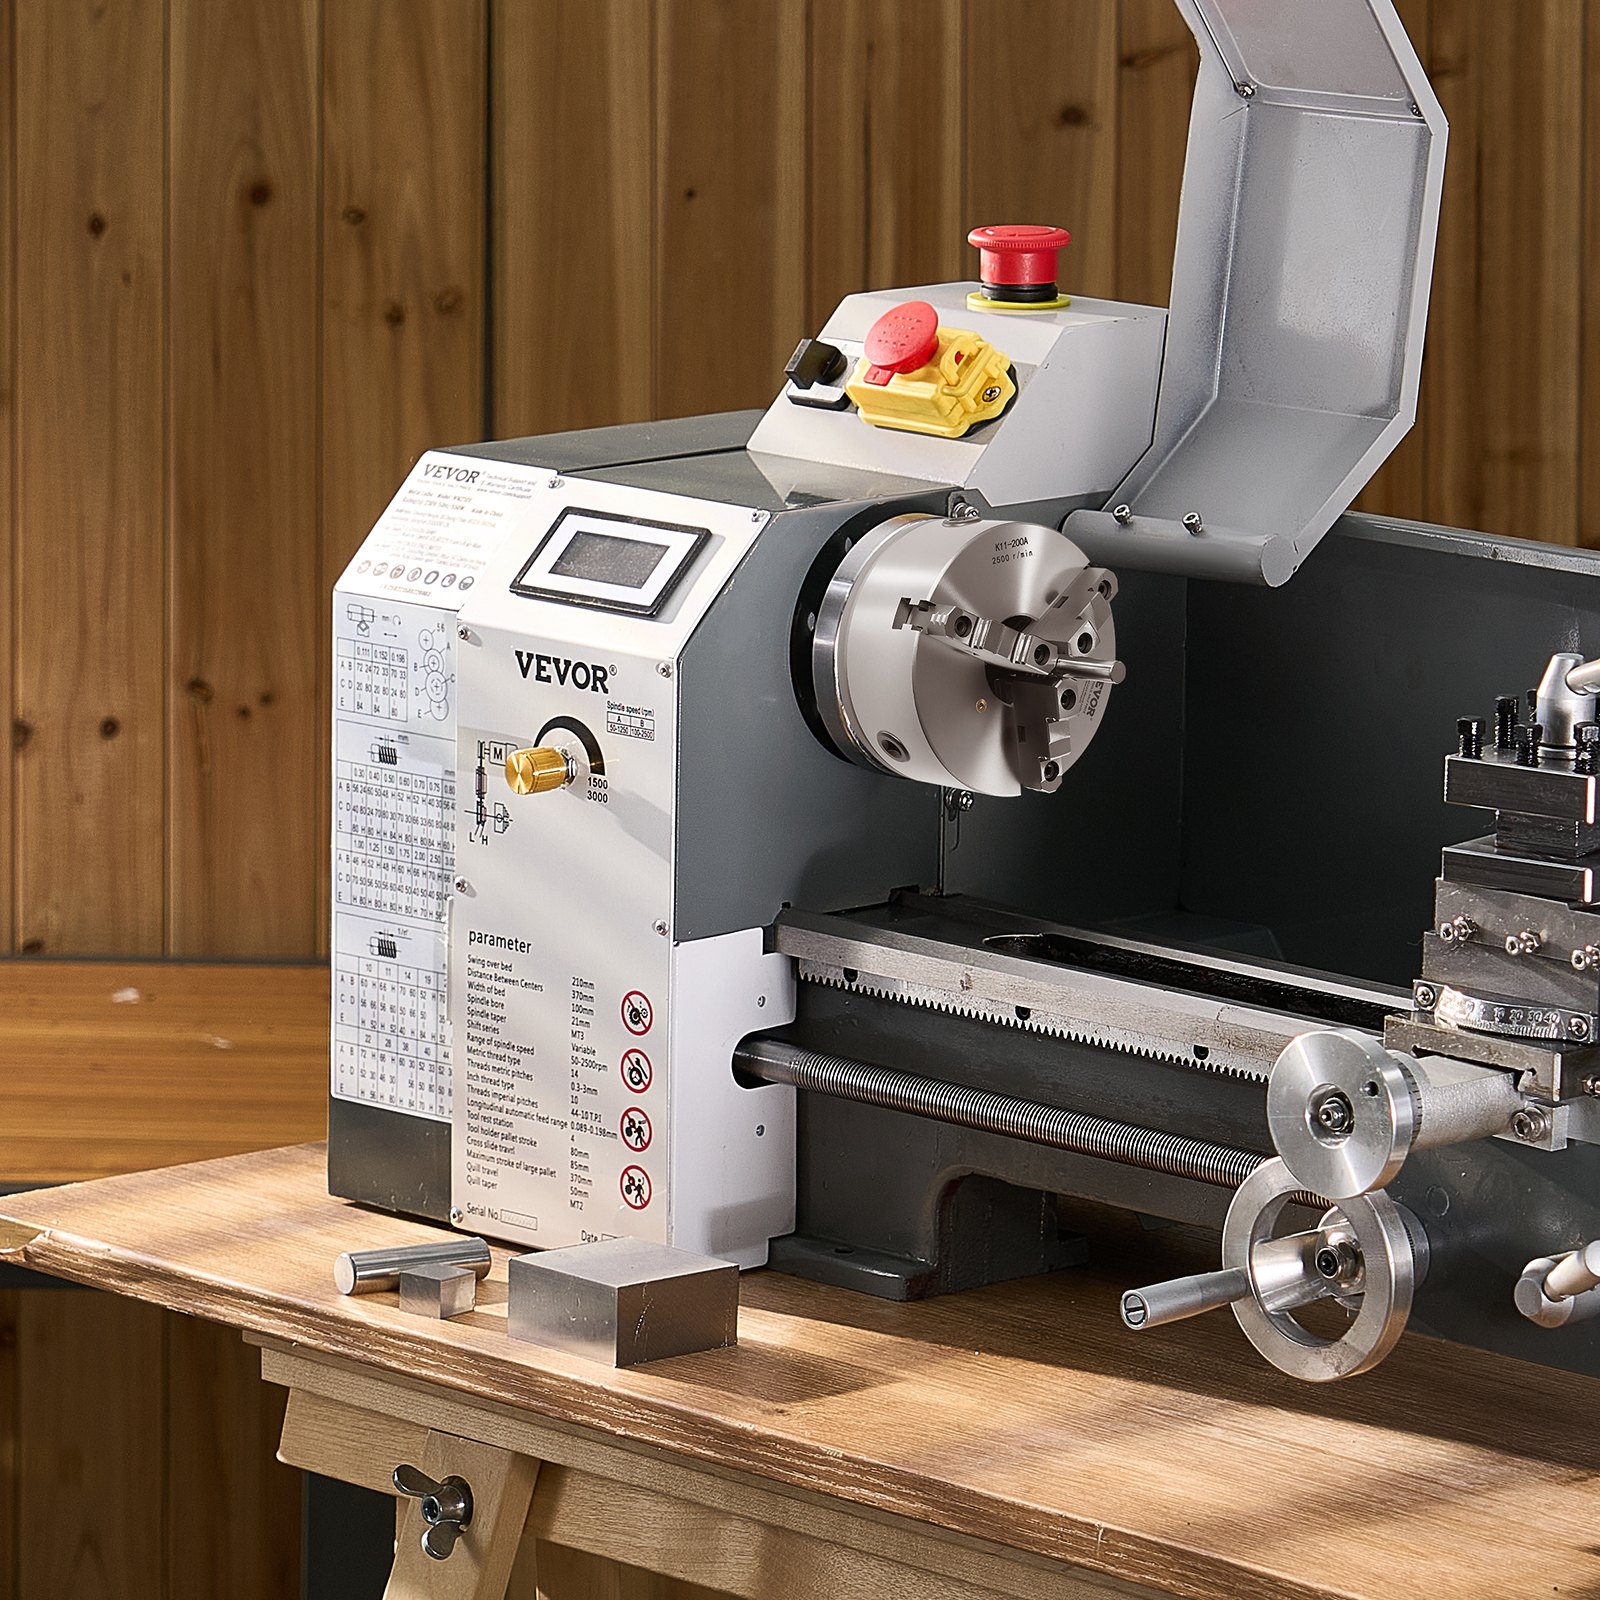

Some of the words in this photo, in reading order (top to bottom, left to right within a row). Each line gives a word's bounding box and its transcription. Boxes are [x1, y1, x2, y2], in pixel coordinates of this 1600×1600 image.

[424, 464, 480, 484] VEVOR
[995, 537, 1029, 552] K11-200A
[992, 555, 1010, 565] 2500
[1013, 550, 1033, 560] r/min
[446, 642, 451, 650] A
[374, 650, 388, 661] 0.152
[341, 697, 345, 706] E
[1087, 681, 1104, 717] EVOR
[418, 709, 422, 719] E
[607, 701, 625, 711] Spindle
[626, 706, 641, 715] speed
[494, 747, 504, 761] M
[354, 768, 365, 778] 0.30
[369, 771, 380, 781] 0.40
[384, 774, 395, 784] 0.50
[414, 779, 426, 790] 0.70
[429, 782, 441, 792] 0.75
[588, 777, 609, 790] 1500
[587, 790, 609, 804] 3000
[469, 832, 475, 843] L
[482, 836, 488, 846] H
[369, 842, 380, 853] 1.25
[384, 845, 395, 855] 1.50
[399, 848, 410, 859] 1.75
[430, 854, 441, 864] 2.50
[469, 930, 532, 954] parameter
[468, 955, 485, 968] Swing
[487, 961, 500, 969] over
[501, 962, 512, 972] bed
[468, 968, 492, 981] Distance
[494, 974, 519, 987] Between
[521, 979, 543, 992] Centers
[572, 977, 595, 990] 210mm
[468, 981, 486, 992] Width
[487, 986, 493, 994] of
[494, 987, 505, 997] bed
[572, 990, 595, 1003] 370mm
[467, 994, 490, 1007] Spindle
[491, 999, 505, 1009] bore
[467, 1007, 490, 1020] Spindle
[491, 1013, 507, 1024] taper
[572, 1003, 594, 1016] 100mm
[467, 1020, 481, 1030] Shift
[482, 1024, 500, 1035] series
[572, 1017, 590, 1028] 21mm
[571, 1030, 584, 1040] MT3
[467, 1033, 485, 1047] Range
[487, 1037, 494, 1046] of
[494, 1039, 515, 1052] spindle
[517, 1044, 534, 1057] speed
[571, 1043, 596, 1056] Variable
[467, 1046, 486, 1057] Metric
[487, 1051, 507, 1062] thread
[508, 1056, 521, 1067] type
[571, 1056, 608, 1072] 50-2500rpm
[468, 1059, 490, 1071] Threads
[492, 1065, 510, 1076] metric
[512, 1070, 533, 1082] pitches
[571, 1069, 579, 1078] 14
[467, 1072, 480, 1082] Inch
[481, 1075, 500, 1087] thread
[501, 1080, 515, 1091] type
[571, 1082, 598, 1096] 0.3-3mm
[468, 1085, 490, 1097] Threads
[492, 1091, 515, 1104] imperial
[517, 1098, 538, 1109] pitches
[571, 1095, 579, 1105] 10
[467, 1098, 504, 1114] Longitudinal
[506, 1107, 535, 1120] automatic
[536, 1113, 550, 1124] feed
[551, 1119, 568, 1130] range
[467, 1110, 479, 1121] Tool
[481, 1114, 492, 1123] rest
[493, 1117, 514, 1128] station
[571, 1109, 589, 1120] 44-10
[467, 1123, 479, 1133] Tool
[481, 1127, 500, 1139] holder
[501, 1133, 518, 1143] pallet
[519, 1137, 537, 1147] stroke
[571, 1122, 617, 1139] 0.089-0.198mm
[467, 1136, 483, 1147] Cross
[485, 1140, 498, 1151] slide
[571, 1148, 589, 1159] 80mm
[467, 1150, 495, 1163] Maximum
[496, 1157, 514, 1168] stroke
[516, 1160, 522, 1169] of
[523, 1163, 538, 1175] large
[540, 1168, 557, 1178] pallet
[467, 1162, 480, 1173] Quill
[482, 1167, 498, 1177] travel
[571, 1161, 589, 1172] 85mm
[467, 1175, 480, 1186] Quill
[482, 1180, 498, 1190] taper
[571, 1174, 593, 1186] 370mm
[570, 1187, 589, 1198] 50mm
[467, 1202, 486, 1217] Serial
[570, 1200, 584, 1211] MT2
[582, 1230, 598, 1244] Date
